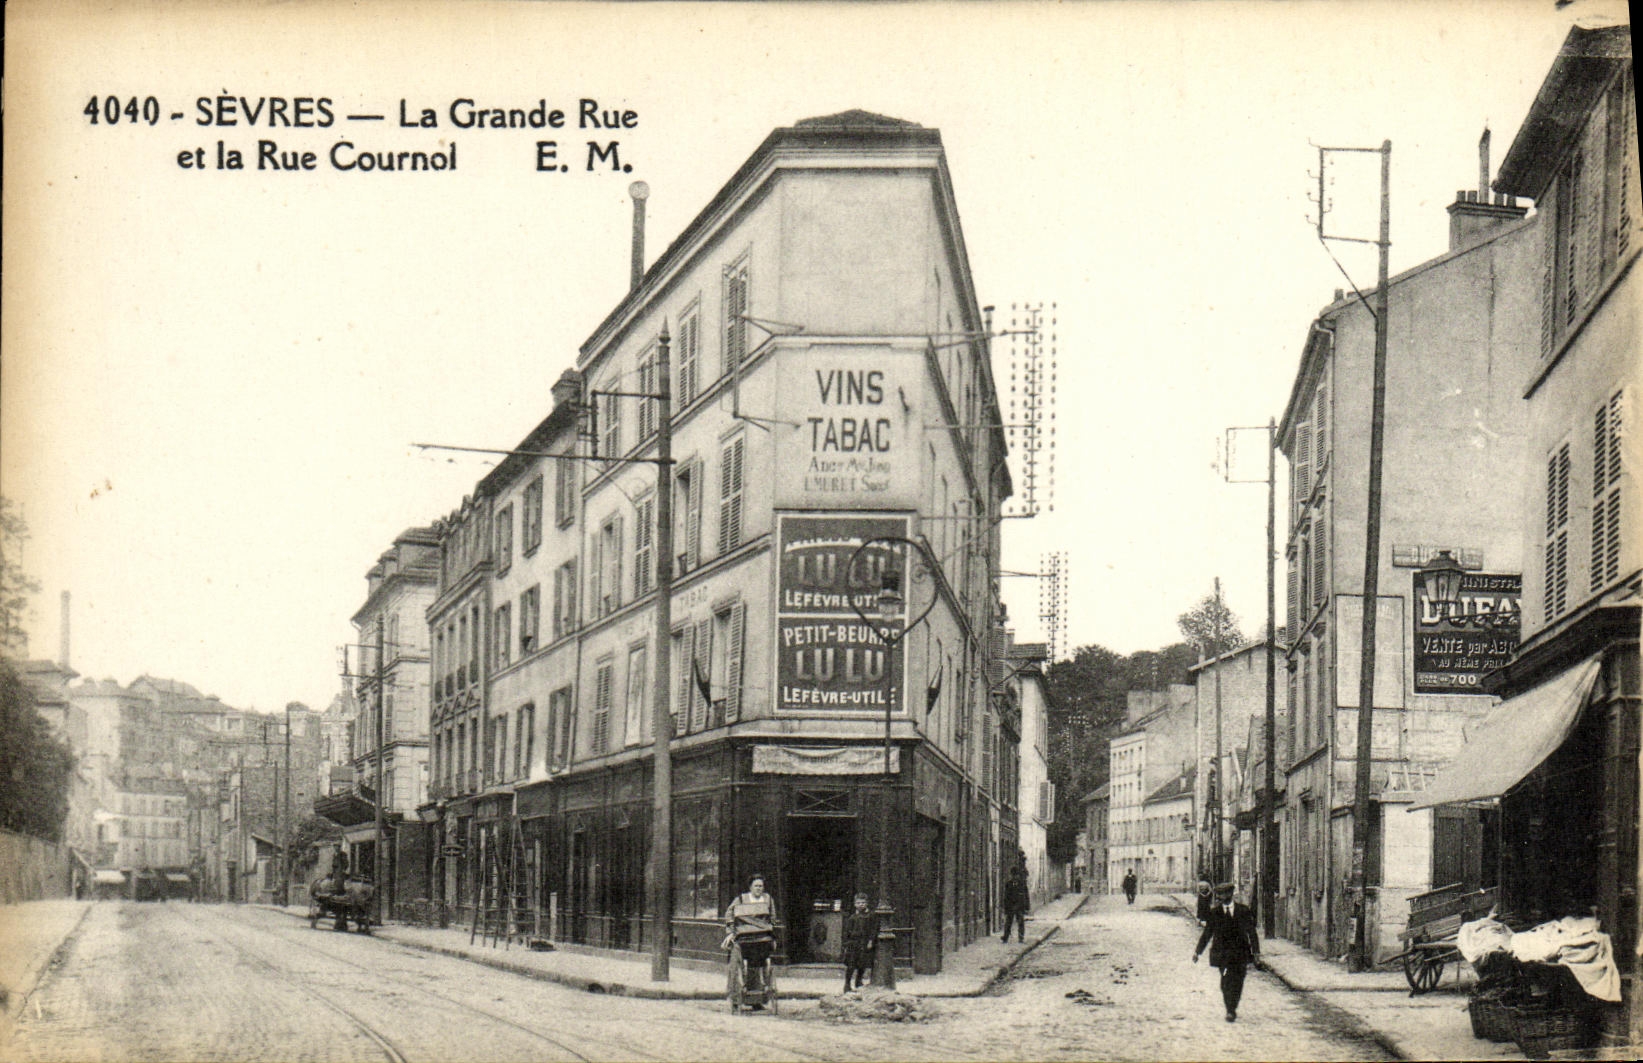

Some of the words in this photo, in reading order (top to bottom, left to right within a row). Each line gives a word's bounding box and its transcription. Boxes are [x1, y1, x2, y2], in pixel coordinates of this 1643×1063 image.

[815, 369, 885, 405] VINS
[807, 417, 891, 453] TABAC
[1423, 637, 1464, 654] VENTE
[1450, 674, 1477, 686] 700
